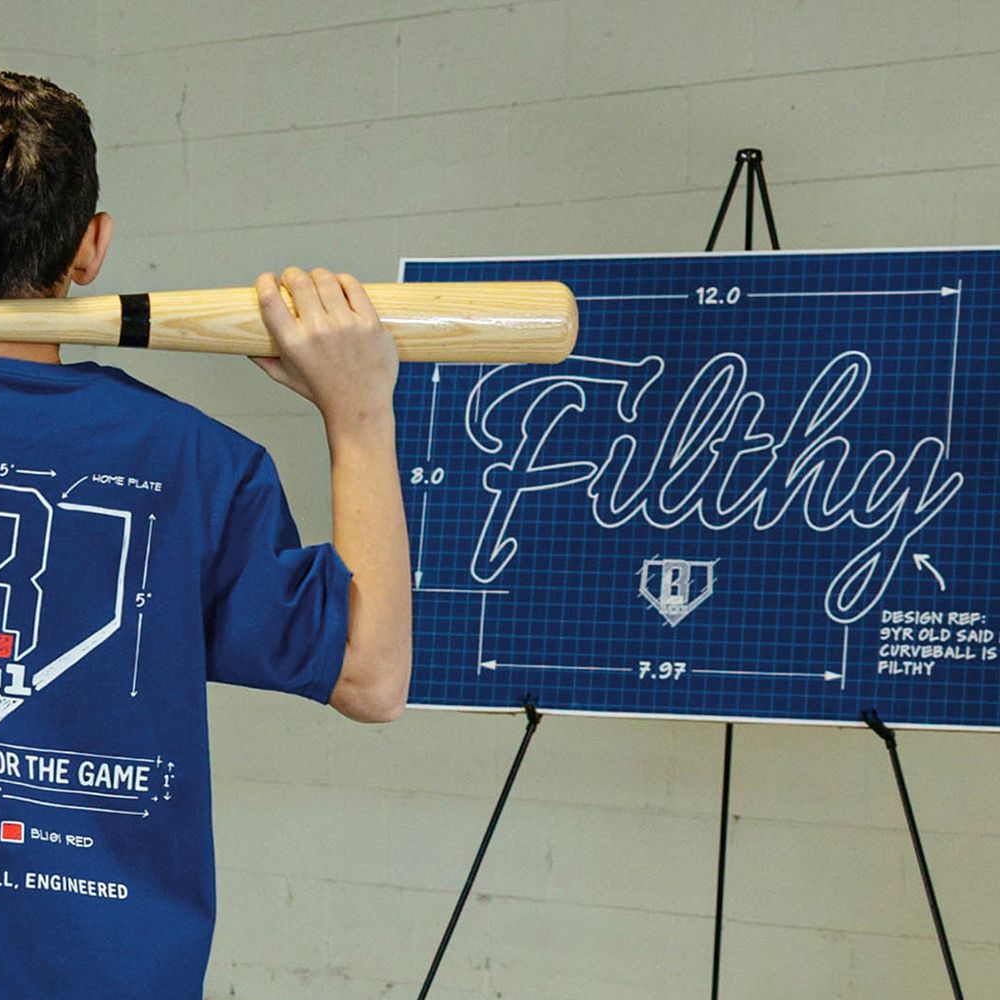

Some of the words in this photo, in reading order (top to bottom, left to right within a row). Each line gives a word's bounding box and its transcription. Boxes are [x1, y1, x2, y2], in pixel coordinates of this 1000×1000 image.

[696, 286, 741, 305] 12.0
[92, 473, 125, 486] HOME
[128, 478, 163, 492] PLATE
[410, 466, 445, 485] 8.0
[465, 350, 964, 623] Filthy
[881, 609, 943, 625] DESIGN
[948, 611, 987, 626] REF:
[880, 626, 915, 641] 9YR
[918, 628, 951, 642] OLD
[956, 629, 994, 643] SAID
[879, 643, 976, 660] CURVEBALL
[981, 646, 998, 660] IS
[639, 661, 687, 680] 7.97
[877, 660, 935, 676] FILTHY
[25, 755, 70, 785] THE
[78, 761, 151, 792] GAME
[66, 835, 94, 848] RED
[25, 872, 128, 899] ENGINEERED
